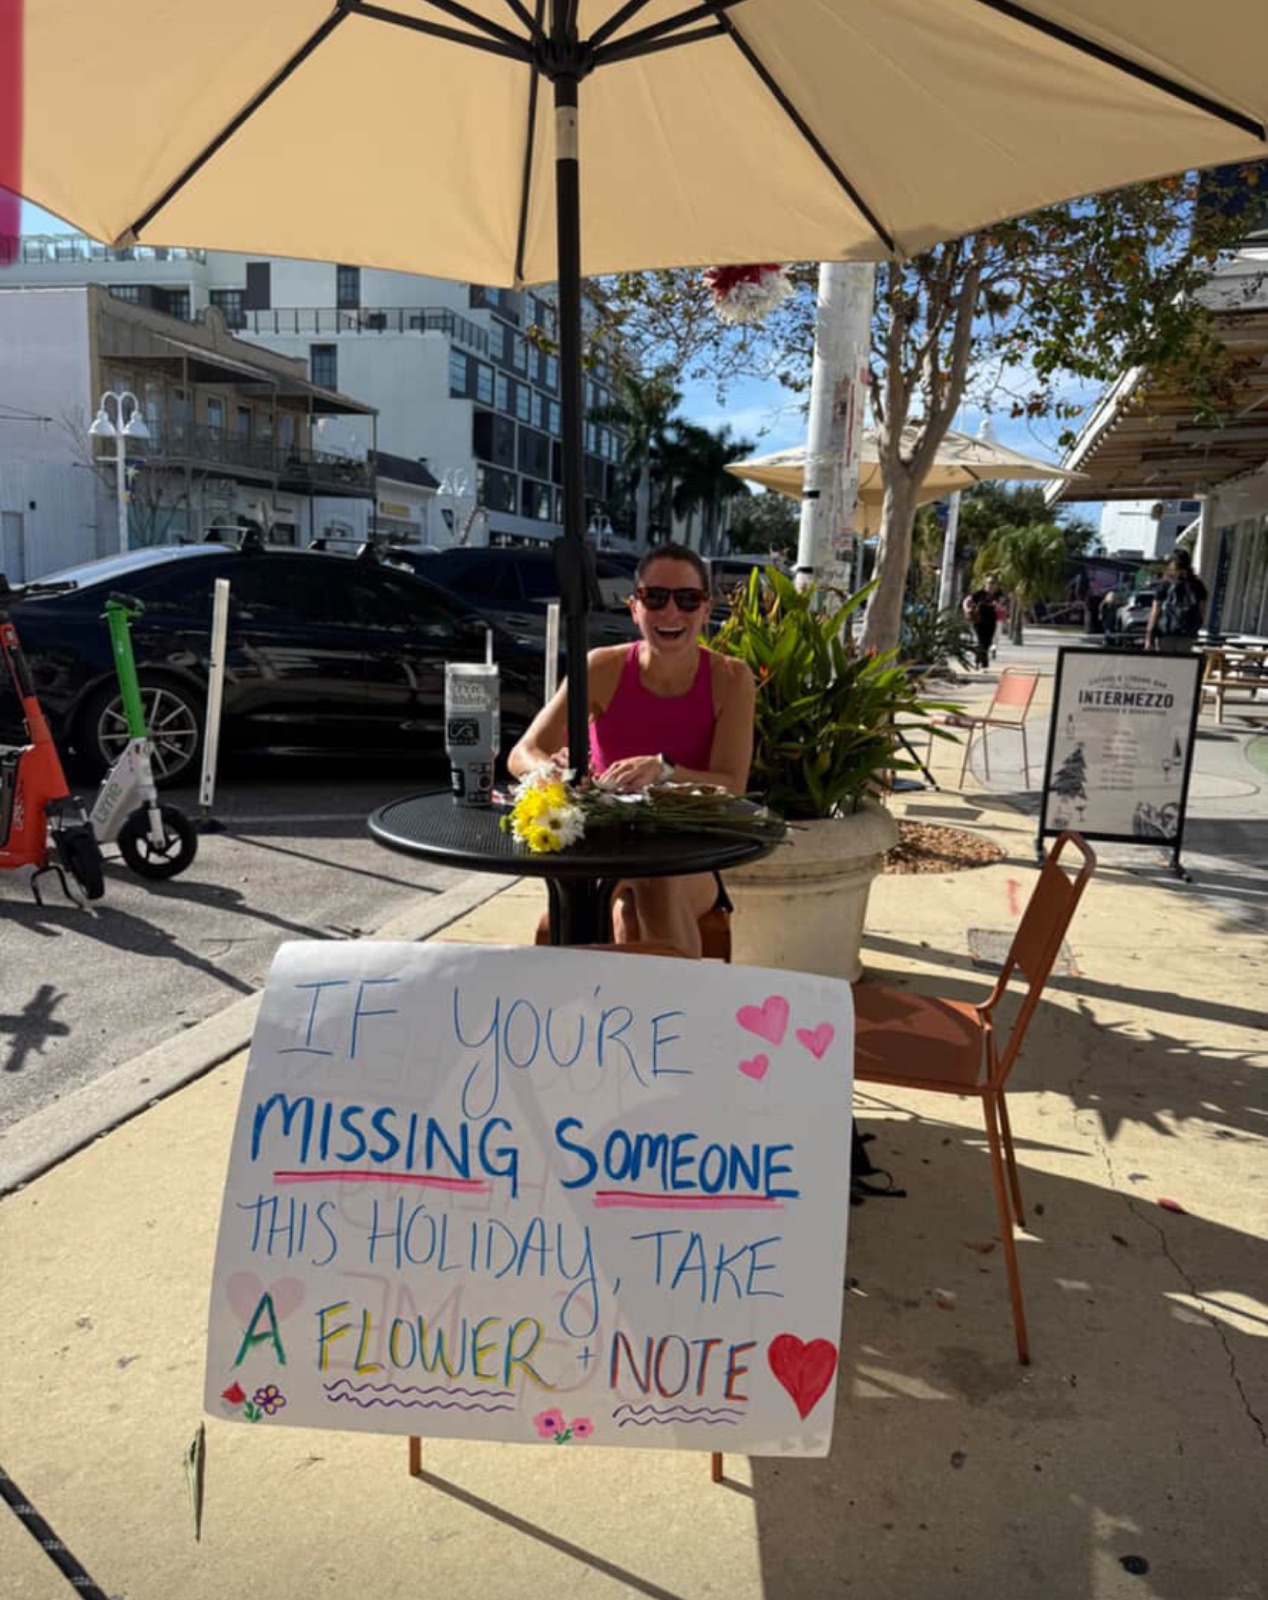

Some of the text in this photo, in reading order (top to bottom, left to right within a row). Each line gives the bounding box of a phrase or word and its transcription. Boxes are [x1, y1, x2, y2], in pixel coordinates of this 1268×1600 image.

[1078, 689, 1174, 708] INTERMEZZO
[276, 977, 694, 1121] IF YOU'RE
[251, 1092, 800, 1199] MISSING SOMEONE
[236, 1194, 785, 1338] THIS HOLIDAY, TAKE
[231, 1291, 287, 1370] A
[316, 1301, 557, 1390] FLOWER
[609, 1330, 758, 1402] NOTE
